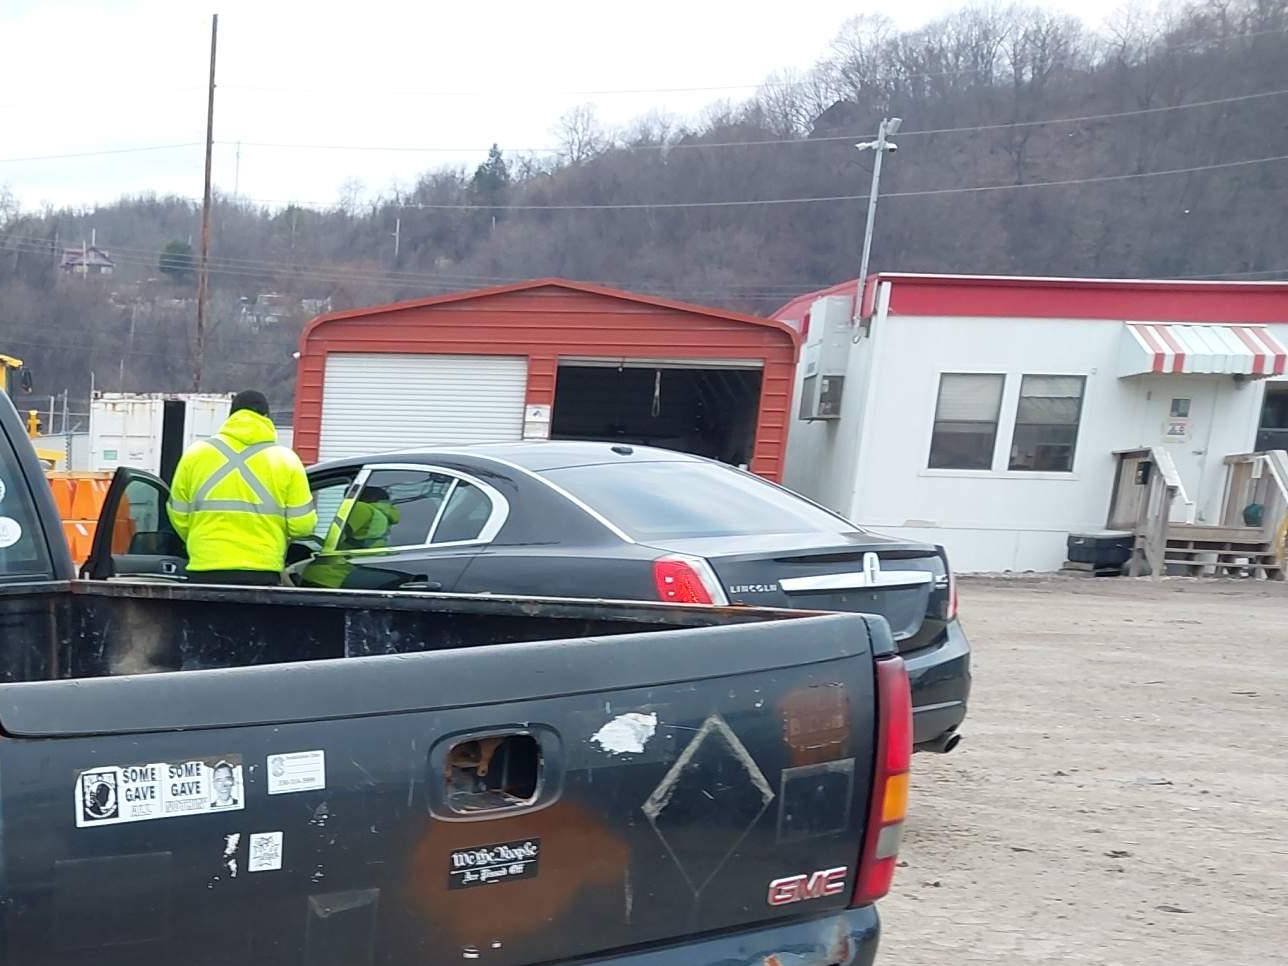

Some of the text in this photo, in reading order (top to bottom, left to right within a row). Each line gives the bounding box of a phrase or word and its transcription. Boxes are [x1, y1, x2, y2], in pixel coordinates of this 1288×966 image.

[729, 584, 777, 594] LINCOLN
[122, 767, 157, 784] SOME
[168, 762, 202, 779] SOME
[125, 785, 157, 802] GAVE
[171, 780, 202, 797] GAVE
[768, 866, 847, 906] GMC
